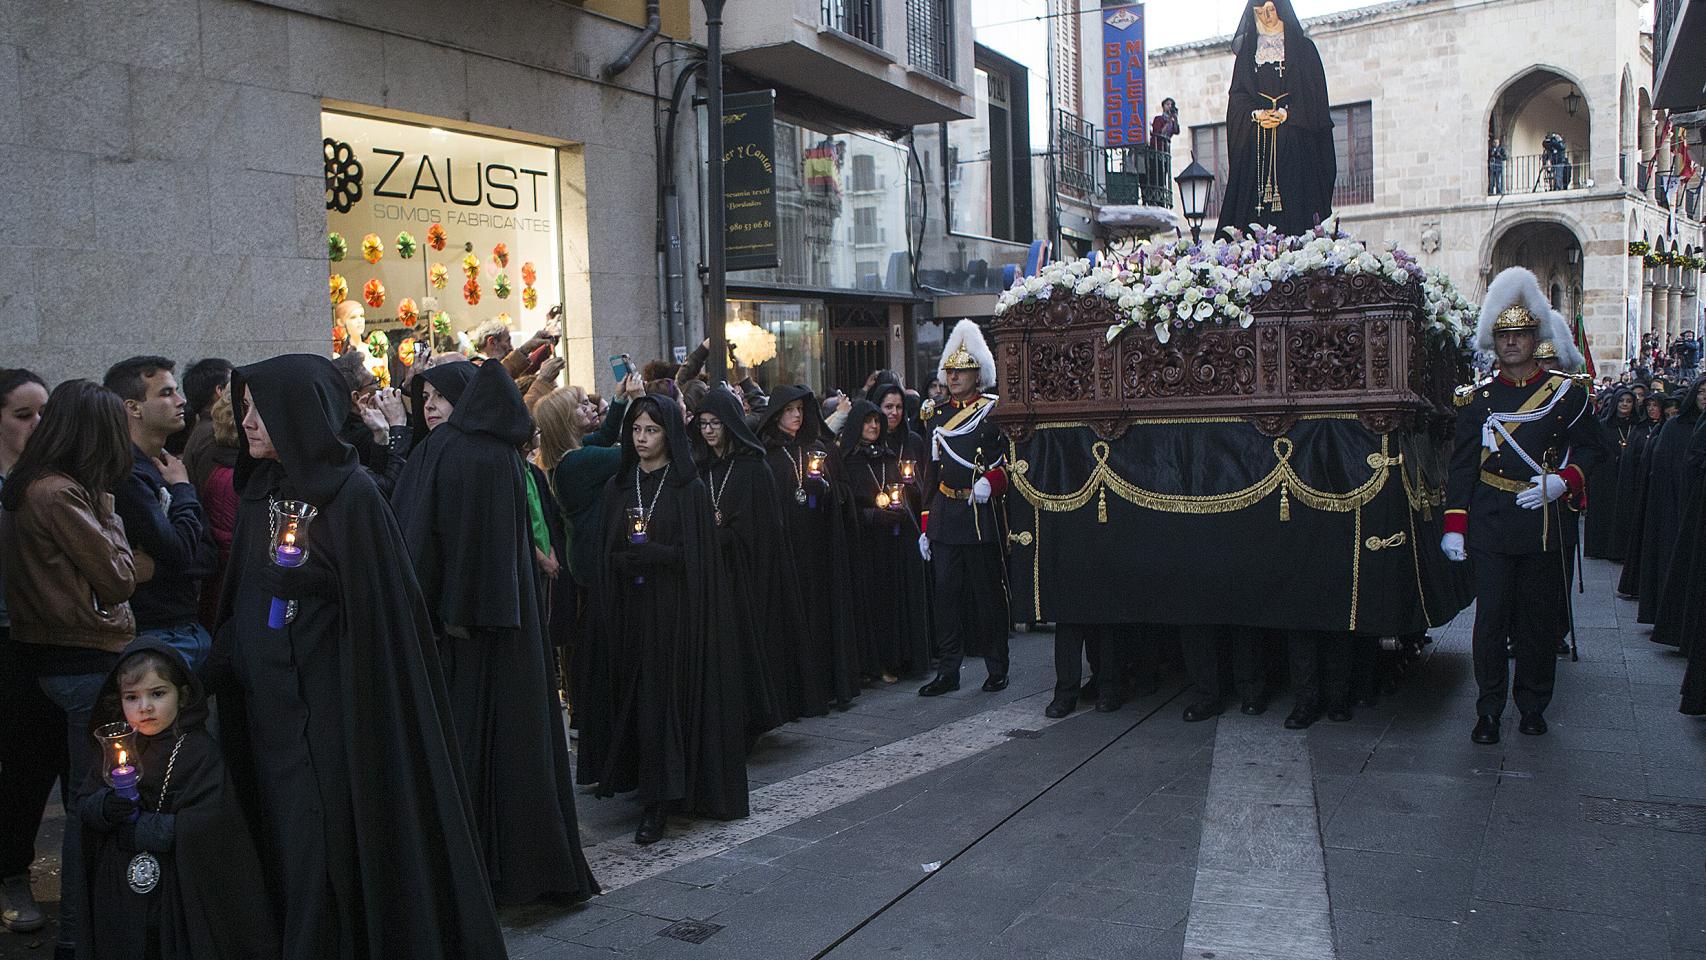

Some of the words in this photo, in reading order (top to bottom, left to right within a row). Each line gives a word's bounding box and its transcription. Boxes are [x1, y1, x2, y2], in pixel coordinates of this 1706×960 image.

[1105, 42, 1123, 144] BOLSOS
[1126, 39, 1143, 143] MALETAS
[372, 147, 548, 212] ZAUST
[746, 143, 773, 173] Cantar
[373, 204, 442, 224] SOMOS
[447, 211, 551, 233] FABRICANTES
[895, 326, 901, 339] 4
